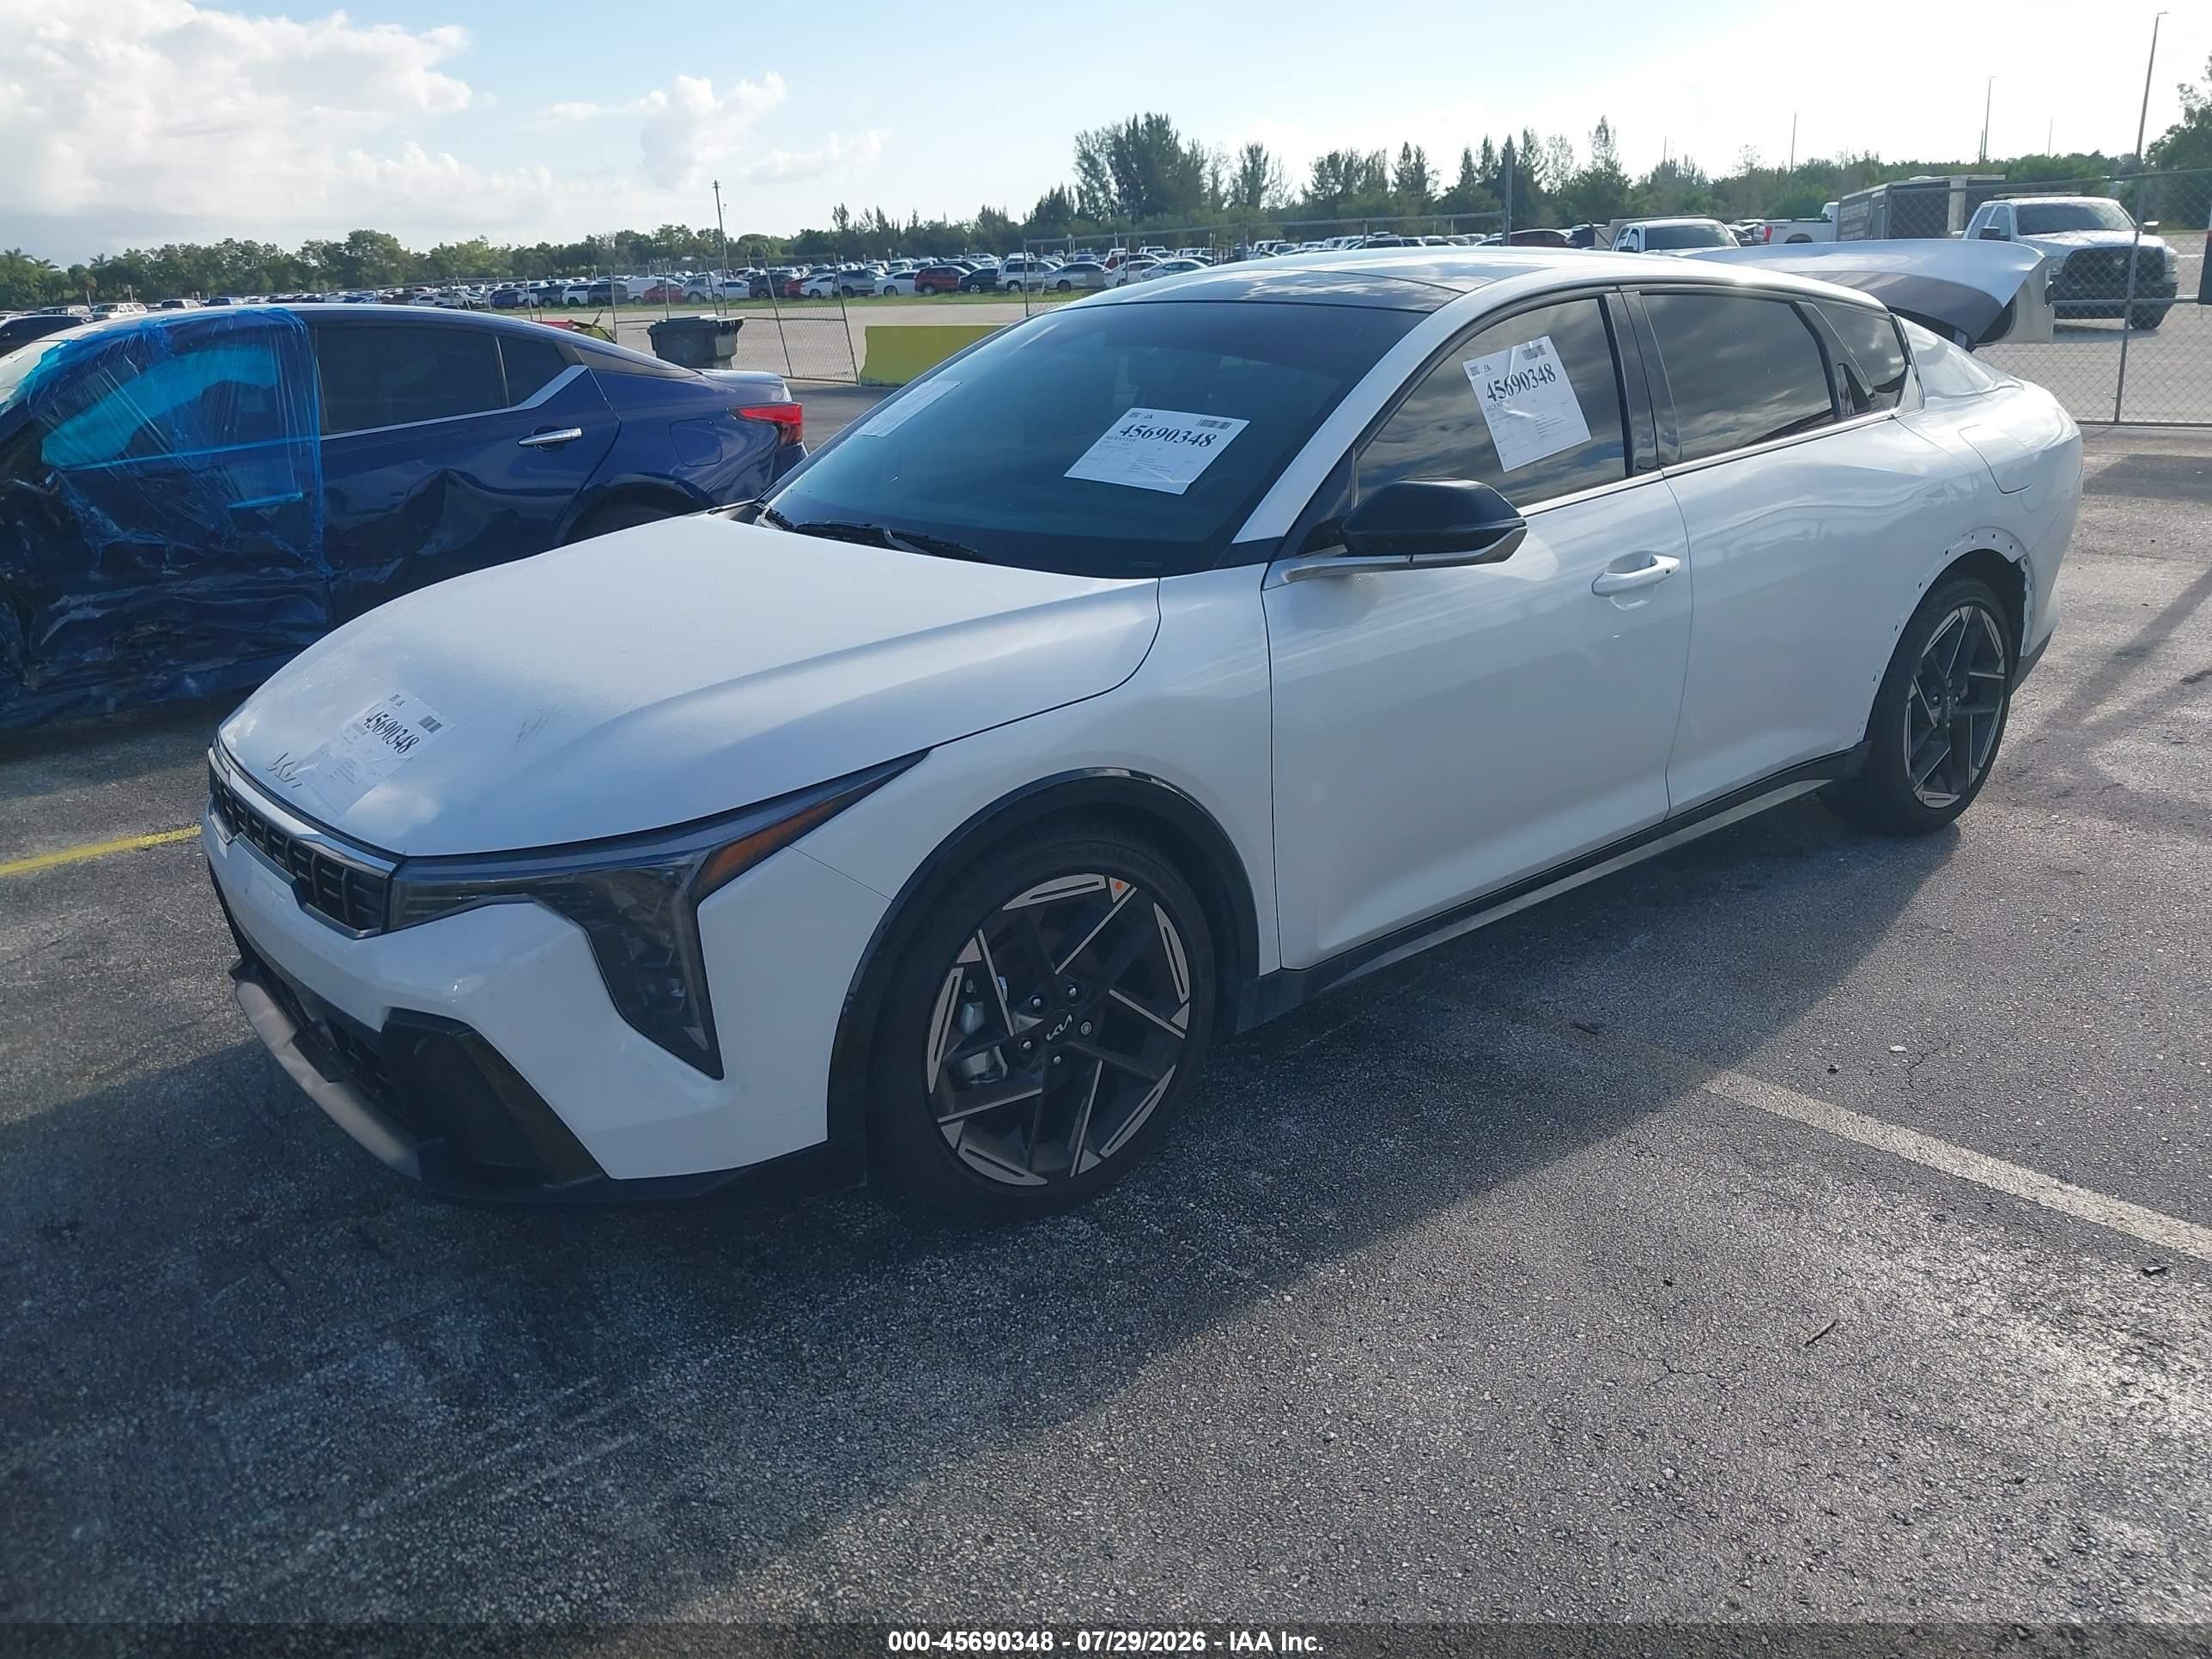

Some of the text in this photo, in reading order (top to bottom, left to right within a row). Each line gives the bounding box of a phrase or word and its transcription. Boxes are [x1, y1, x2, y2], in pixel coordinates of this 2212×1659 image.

[1486, 363, 1557, 402] 45690348
[1119, 423, 1218, 448] 45690348
[363, 710, 421, 755] 45690348
